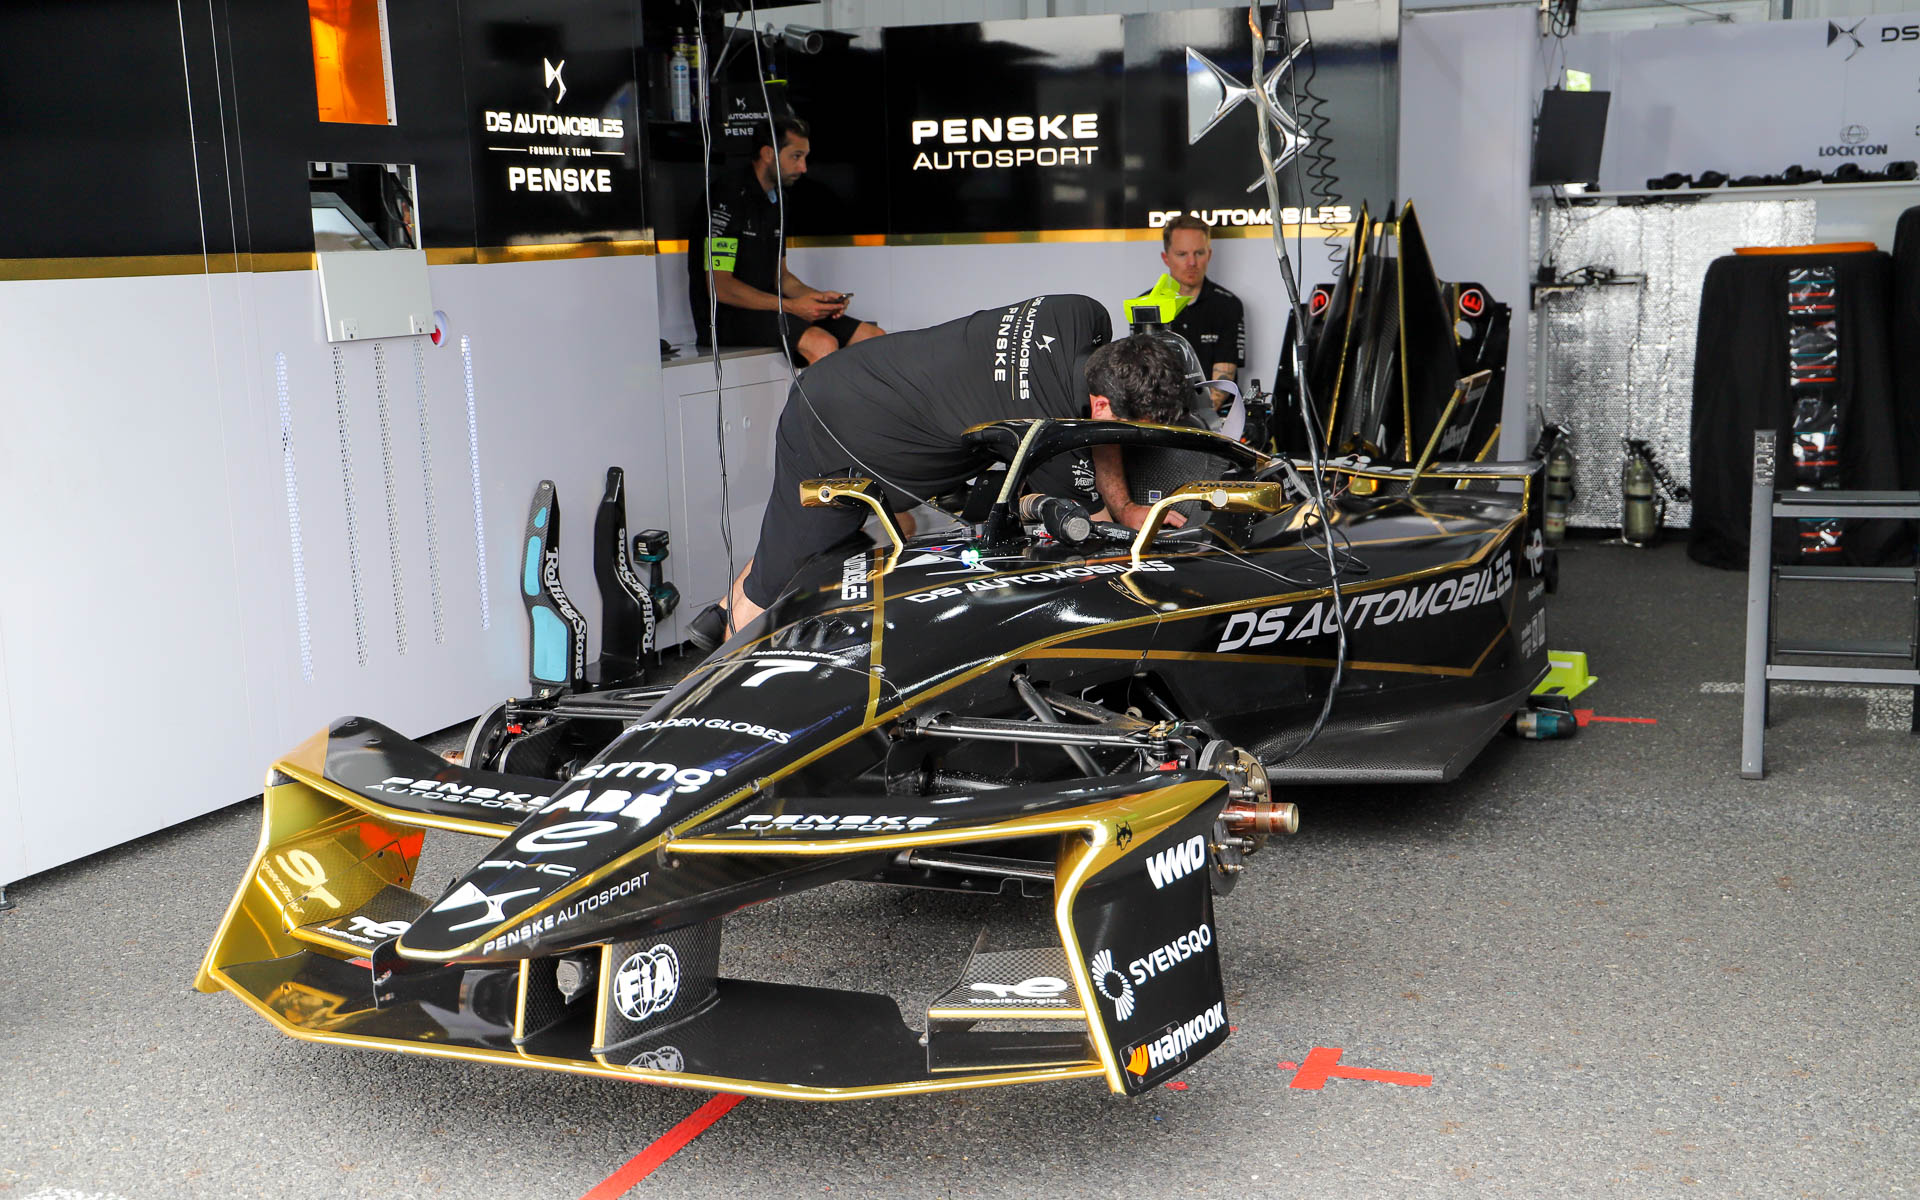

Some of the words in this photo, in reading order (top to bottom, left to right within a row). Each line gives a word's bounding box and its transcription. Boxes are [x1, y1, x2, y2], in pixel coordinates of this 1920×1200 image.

[485, 111, 512, 132] DS
[514, 113, 625, 138] AUTOMOBILES
[912, 114, 1099, 145] PENSKE
[529, 146, 563, 156] FORMULA
[565, 147, 570, 156] E
[572, 148, 592, 156] TEAM
[912, 146, 1099, 171] AUTOSPORT
[1819, 144, 1888, 157] LOCKTON
[508, 167, 612, 192] PENSKE
[994, 307, 1019, 382] PENSKE
[1019, 308, 1038, 400] AUTOMOBILES
[904, 587, 963, 603] DS
[965, 560, 1176, 593] AUTOMOBILES
[1216, 606, 1292, 653] DS
[1285, 550, 1513, 640] AUTOMOBILES
[741, 659, 818, 687] 7
[705, 718, 792, 745] GLOBES
[382, 776, 551, 808] PENSKE
[740, 814, 939, 825] PENSKE
[1146, 835, 1207, 889] WWD
[483, 915, 554, 955] PENSKE
[557, 871, 650, 925] AUTOSPORT
[1129, 924, 1212, 985] SYENSQO
